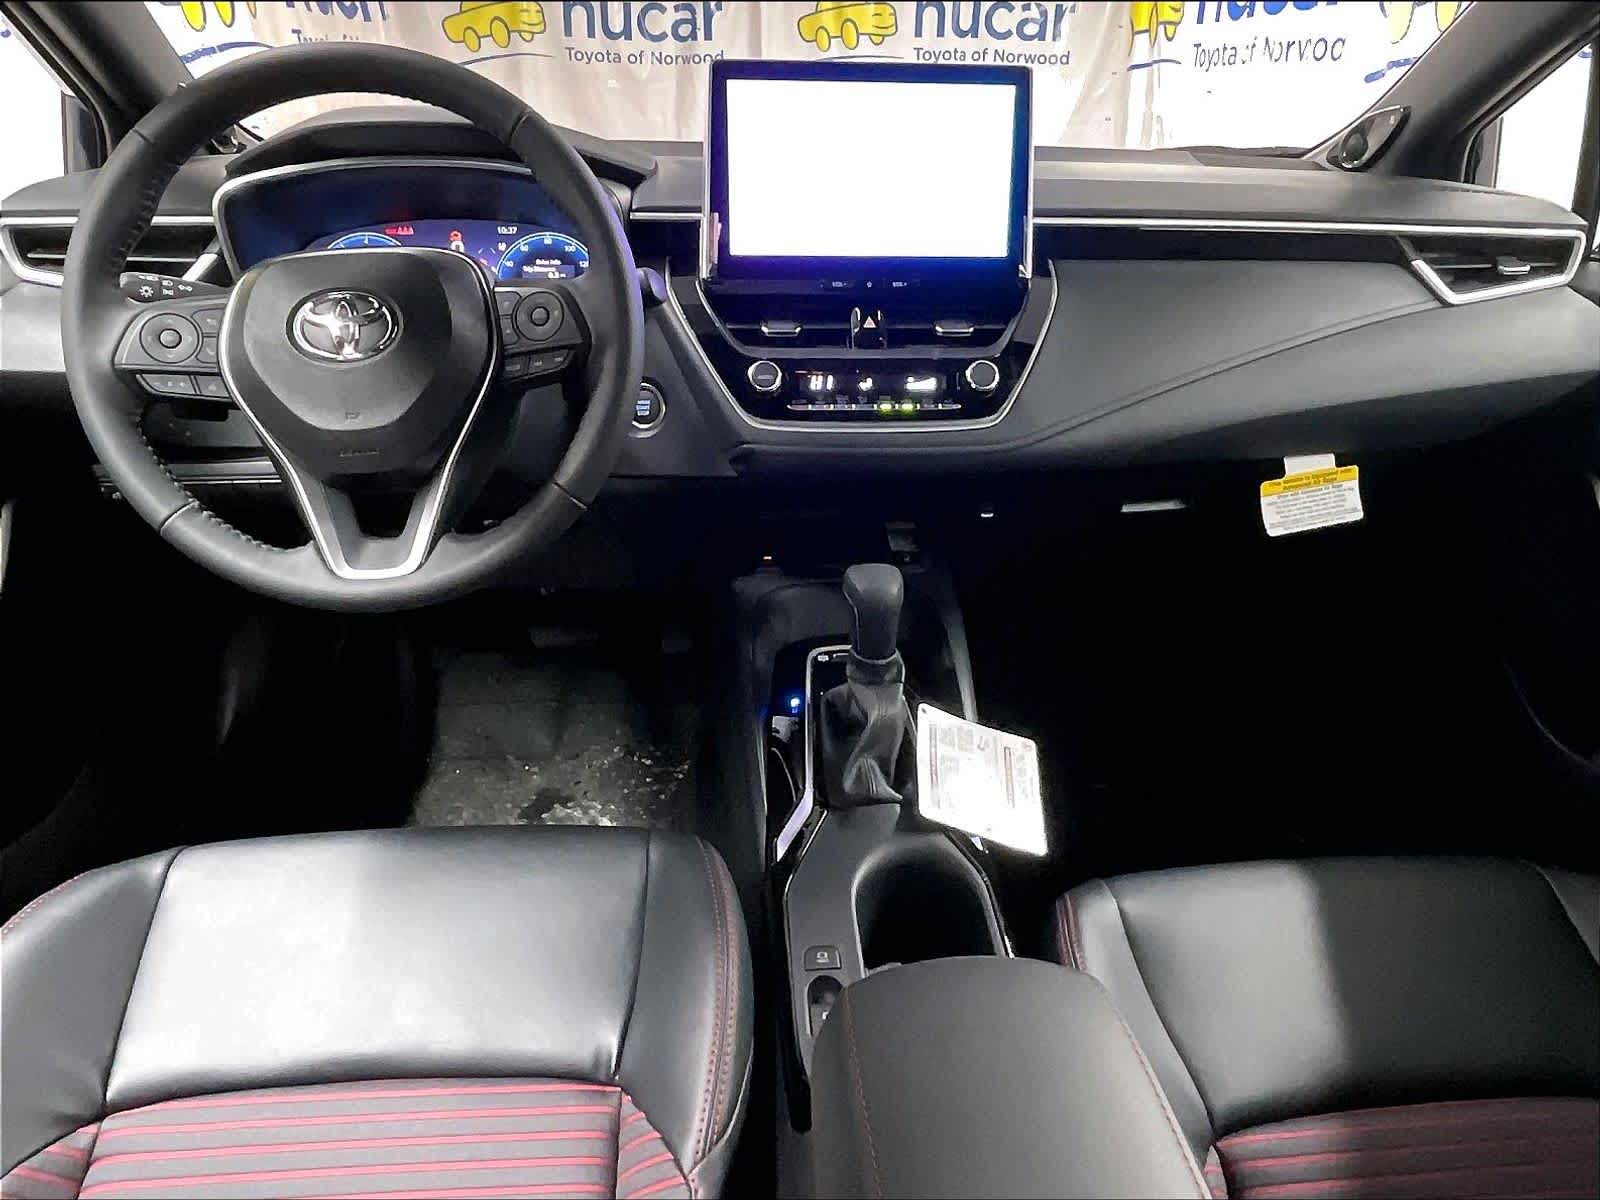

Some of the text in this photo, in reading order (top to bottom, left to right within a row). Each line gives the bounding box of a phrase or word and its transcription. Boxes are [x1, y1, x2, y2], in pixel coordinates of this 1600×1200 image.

[562, 1, 723, 43] nucar
[913, 1, 1076, 42] nucar
[565, 47, 725, 66] Toyota of Norwood
[913, 47, 1070, 65] Toyota of Norwood
